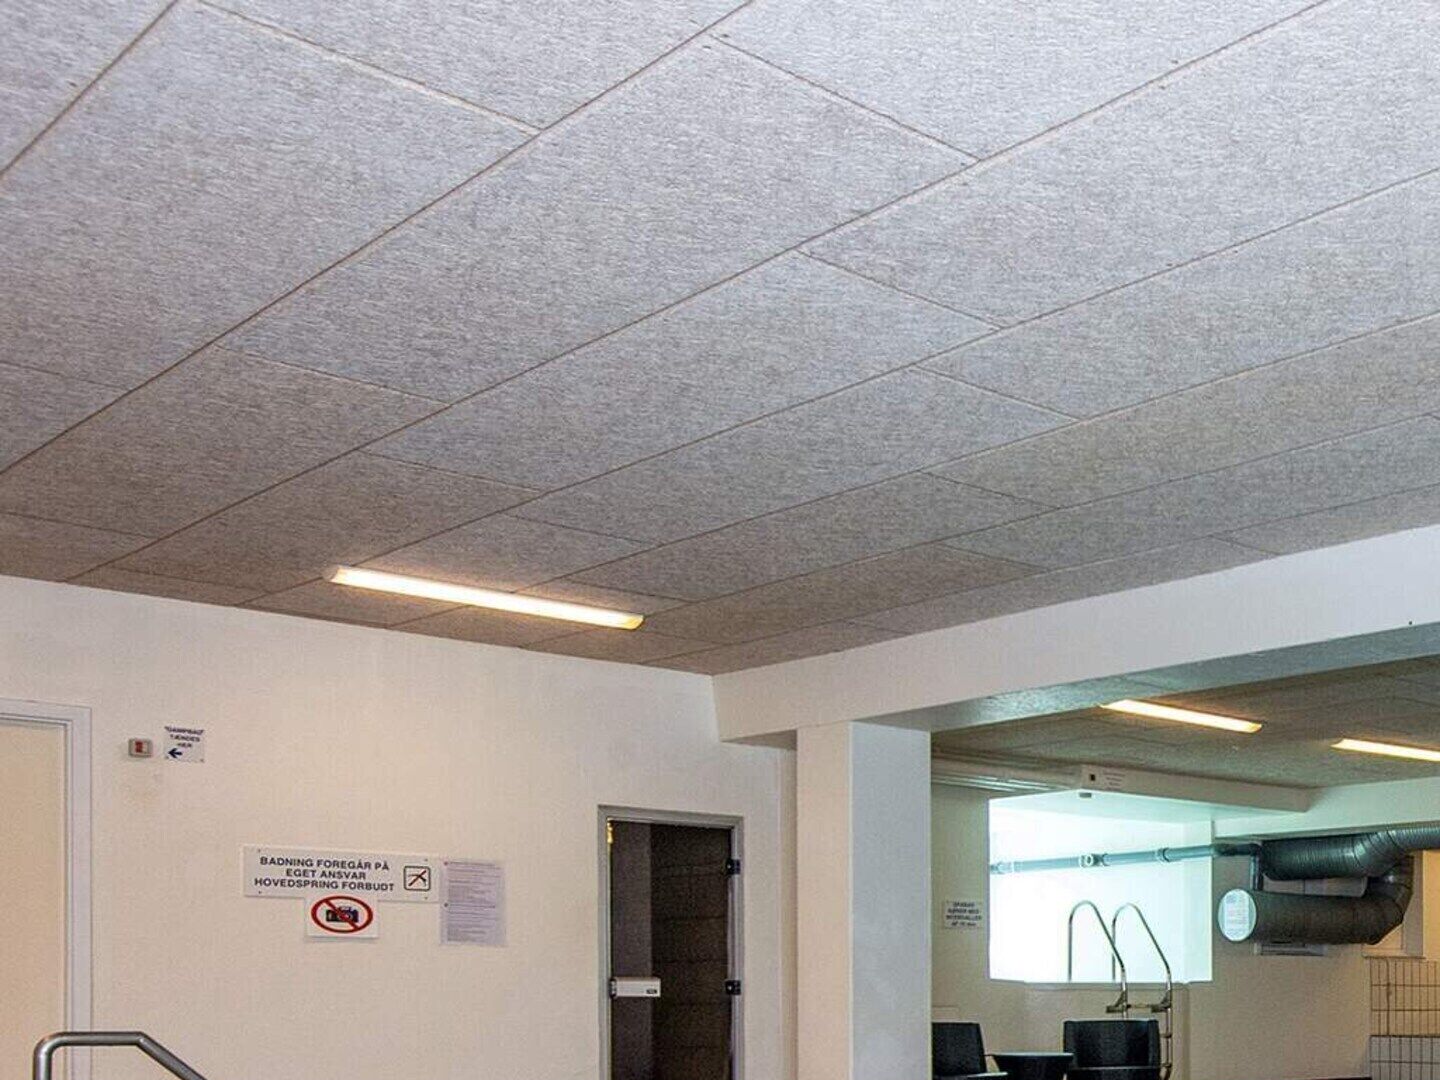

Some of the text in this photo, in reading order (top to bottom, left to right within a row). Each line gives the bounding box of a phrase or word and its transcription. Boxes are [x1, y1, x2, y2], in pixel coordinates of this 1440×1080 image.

[260, 856, 390, 870] BADNING FOREGÅR PÅ
[286, 868, 366, 880] EGET ANSVAR
[254, 878, 394, 891] HOVEDSPRING FORBUDT
